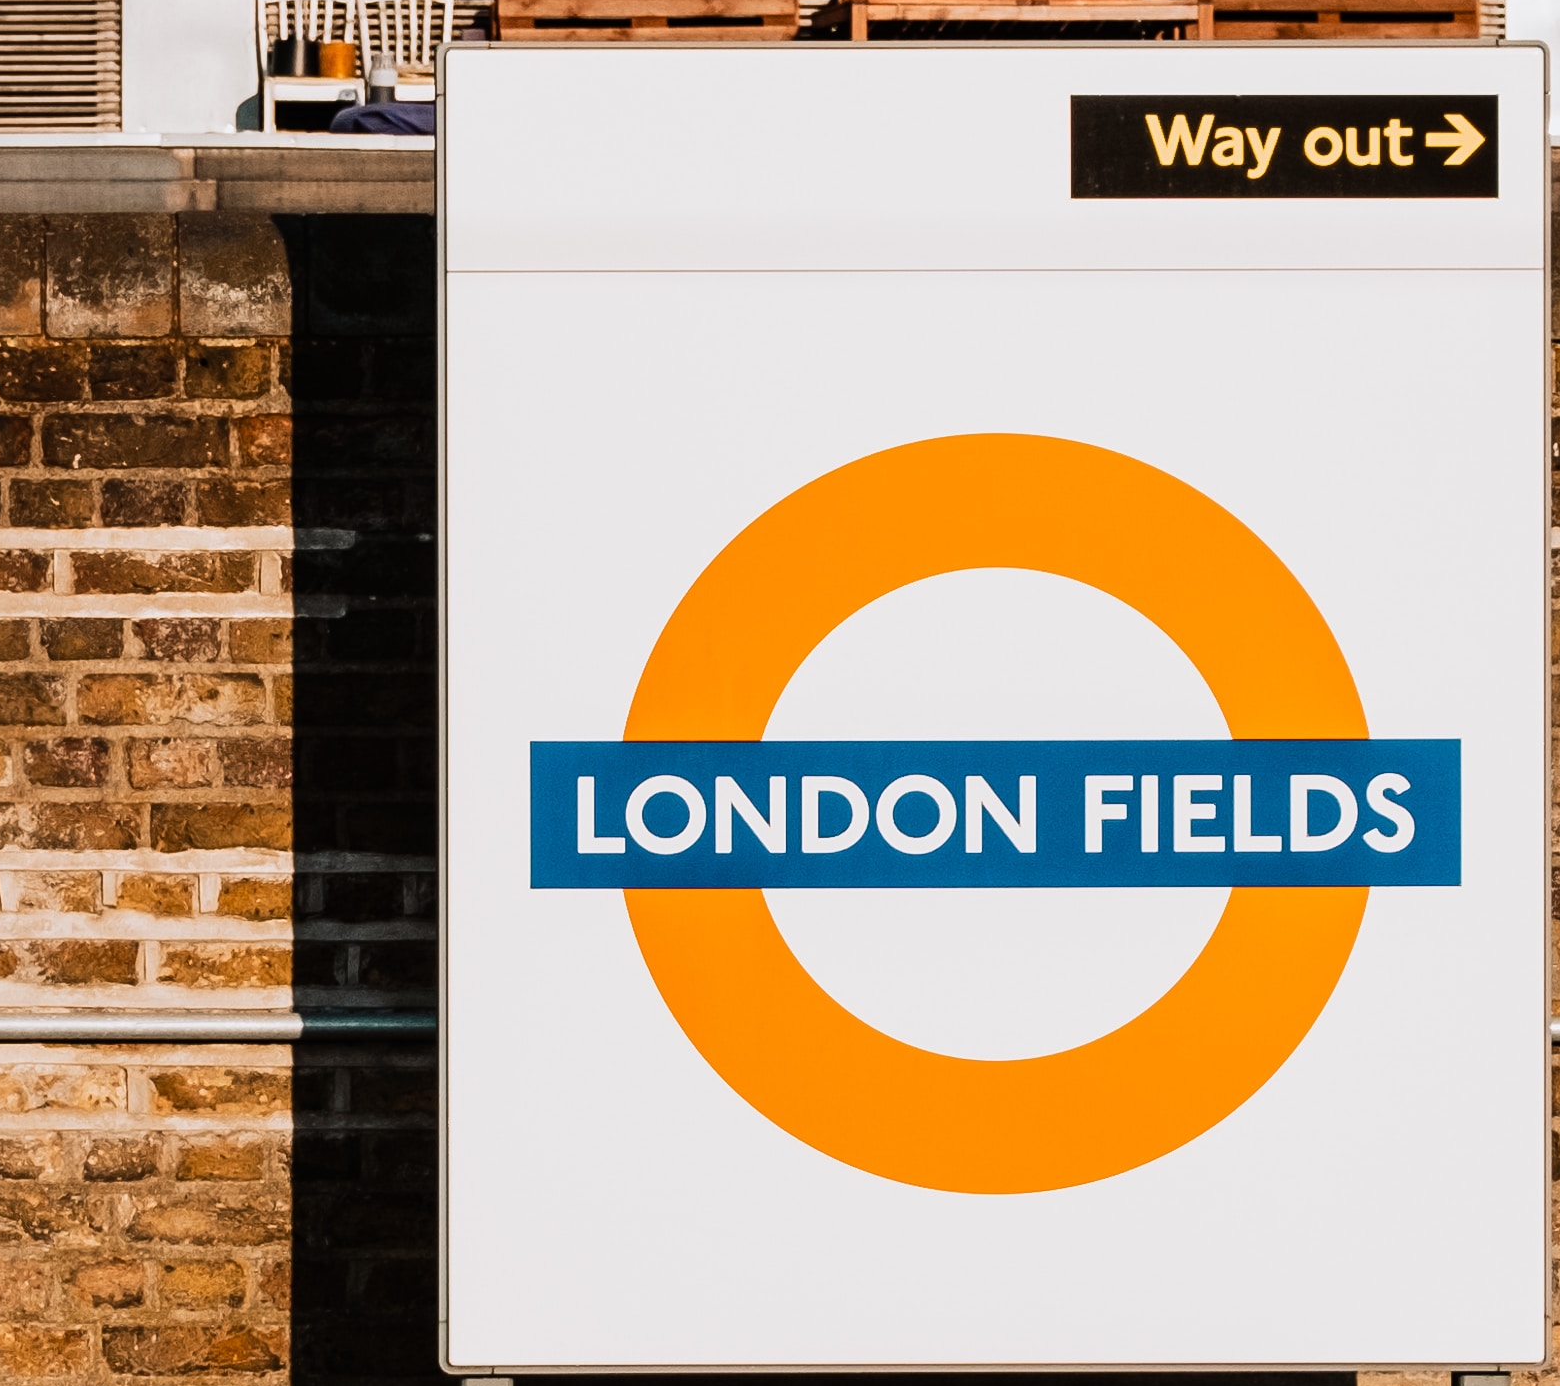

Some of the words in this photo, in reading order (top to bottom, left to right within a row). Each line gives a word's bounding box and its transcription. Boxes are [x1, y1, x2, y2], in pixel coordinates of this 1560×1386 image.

[1144, 114, 1281, 180] Way
[1303, 118, 1414, 167] out
[577, 774, 1037, 855] LONDON
[1084, 772, 1416, 855] FIELDS
